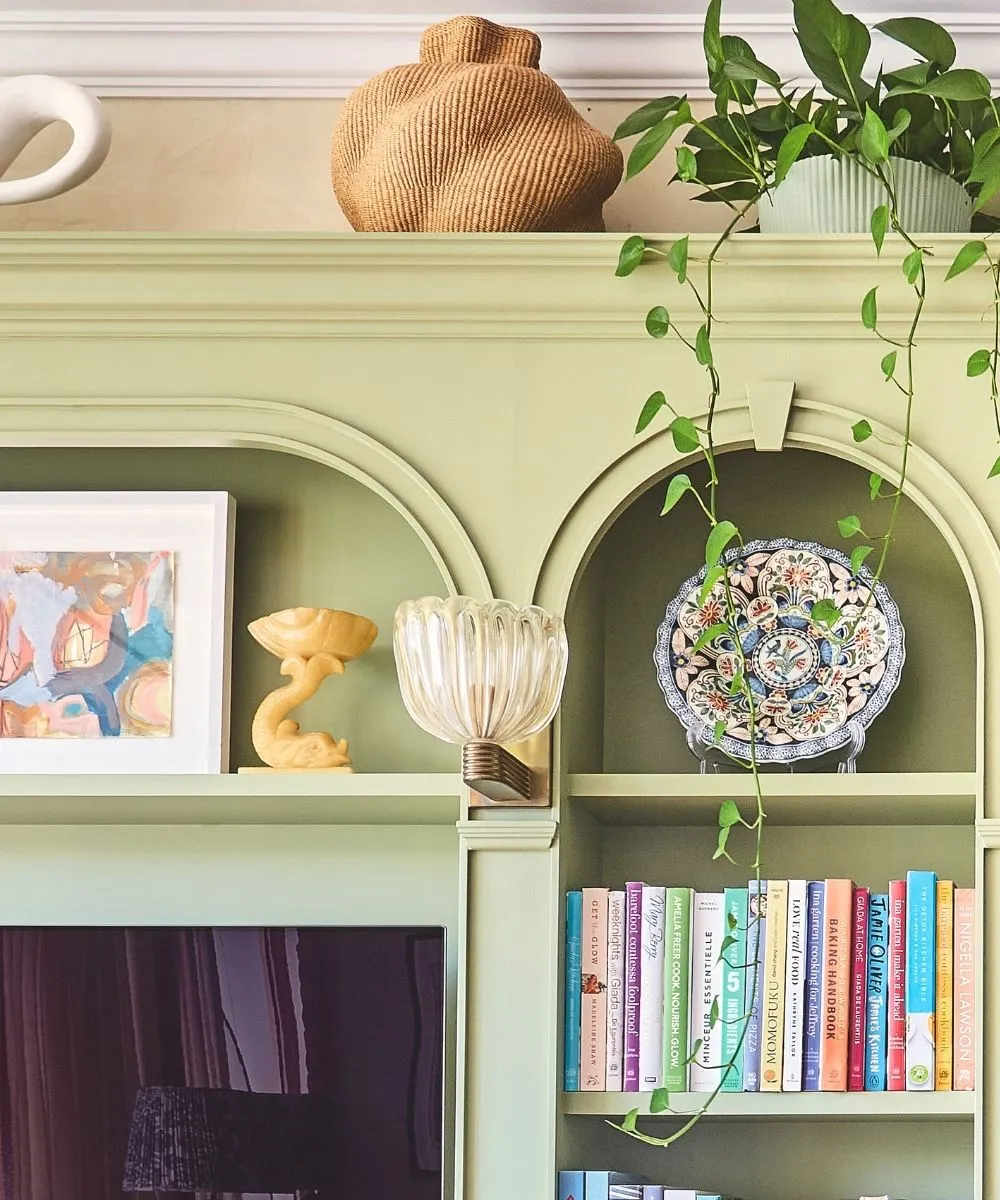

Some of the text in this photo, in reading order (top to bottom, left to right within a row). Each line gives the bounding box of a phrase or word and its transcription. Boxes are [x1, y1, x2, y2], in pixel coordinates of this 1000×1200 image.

[610, 900, 622, 960] weeknights
[629, 889, 641, 935] barefoot
[644, 895, 665, 928] Mary
[674, 895, 682, 930] AMELIA
[810, 907, 822, 941] garten
[855, 896, 865, 962] GIADA AT HOME
[628, 937, 640, 983] contessa
[644, 929, 664, 961] Berry
[673, 932, 681, 960] FREER
[791, 899, 803, 985] LOVE real FOOD
[869, 898, 886, 993] JAMIE OLIVER
[892, 900, 904, 1021] ina garten make it ahead
[960, 922, 973, 986] NIGELLA
[672, 961, 681, 991] COOK.
[727, 971, 740, 993] 5
[808, 946, 820, 986] cooking
[826, 918, 838, 1040] BAKING HANDBOOK
[940, 888, 949, 1053] the barefoot contessa cookbook
[610, 978, 621, 1010] Giada
[627, 985, 640, 1036] foolproof
[671, 992, 680, 1037] NOURISH.
[749, 1006, 757, 1021] OF
[808, 987, 819, 1001] for
[855, 994, 861, 1004] DE
[702, 1013, 711, 1063] MINCEUR
[748, 1024, 757, 1052] PIZZA
[767, 981, 779, 1064] MOMOFUKU
[806, 1002, 818, 1038] Jeffrey
[868, 995, 883, 1073] JAMIE'S KITCHEN
[959, 992, 972, 1061] LAWSON
[670, 1037, 679, 1069] GLOW.
